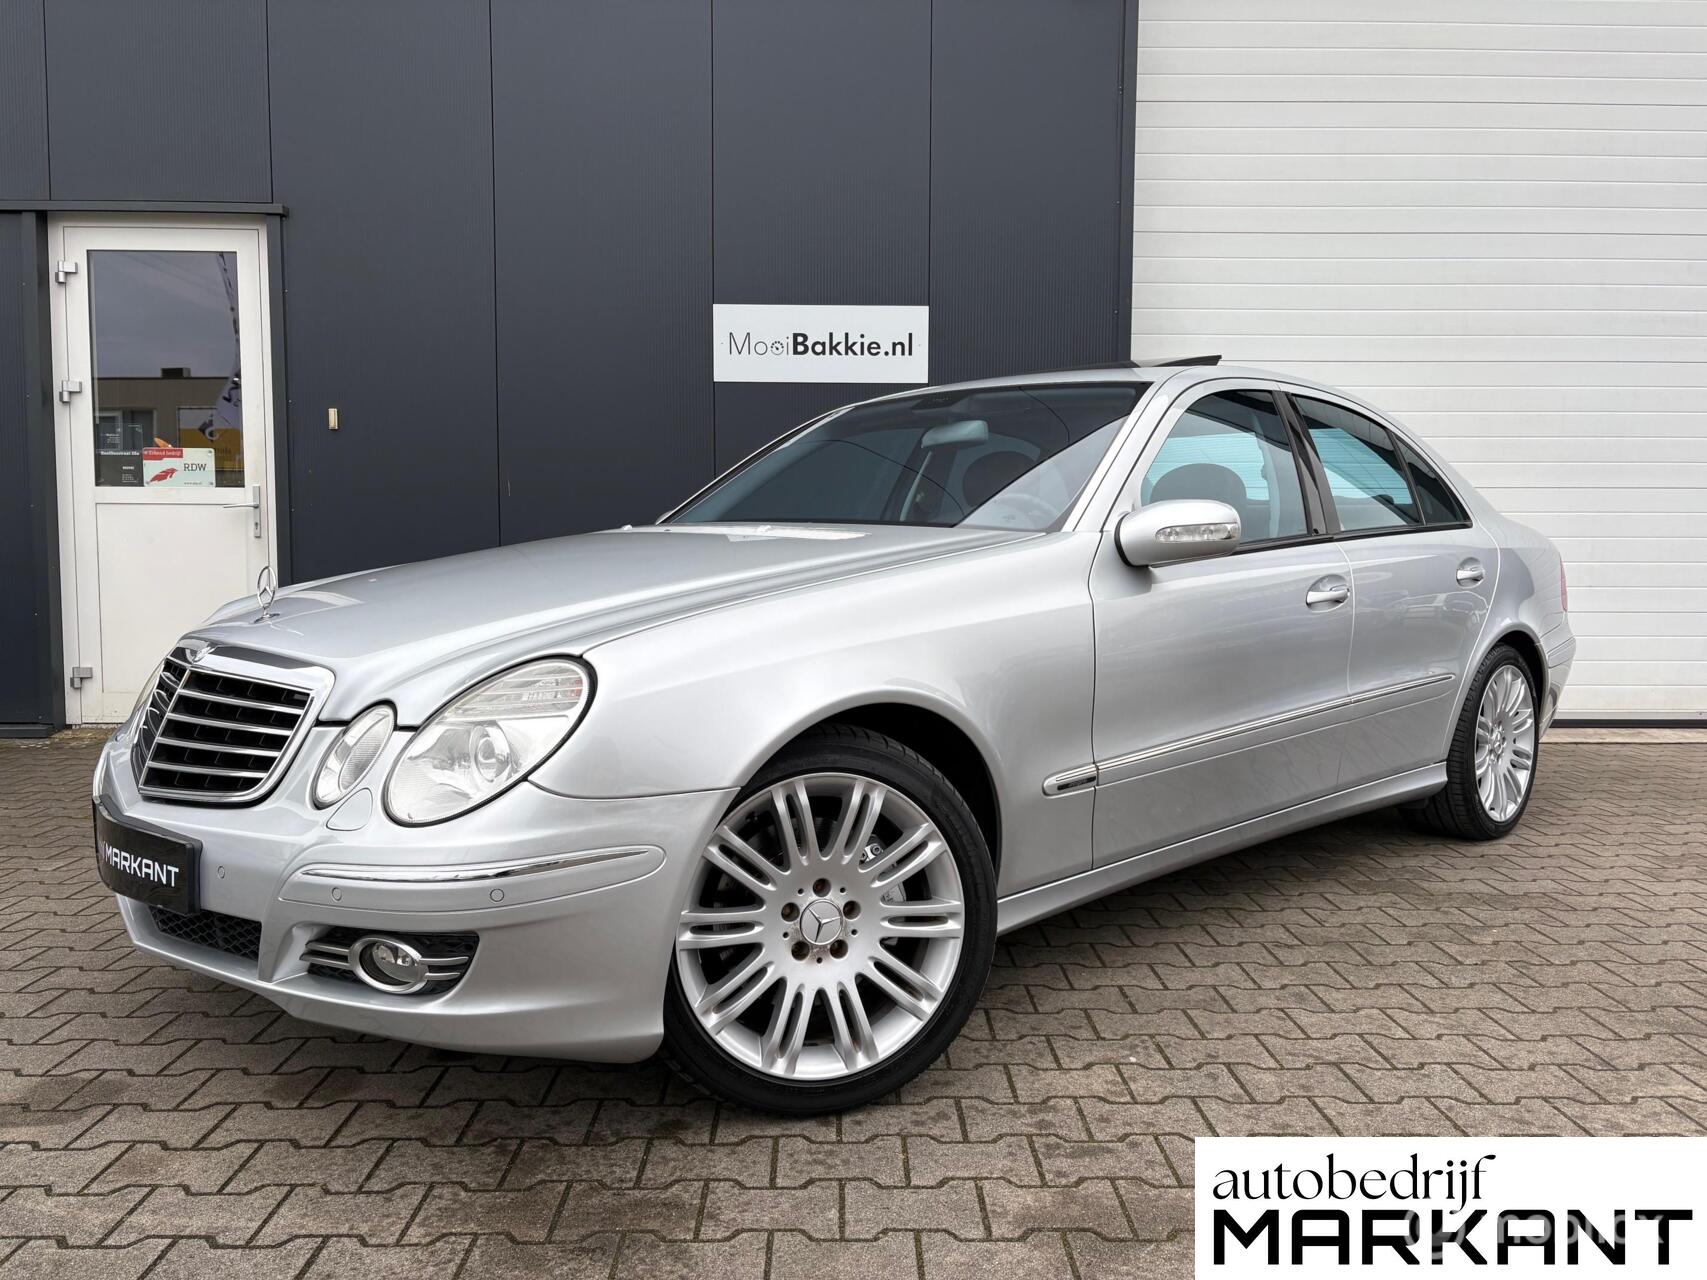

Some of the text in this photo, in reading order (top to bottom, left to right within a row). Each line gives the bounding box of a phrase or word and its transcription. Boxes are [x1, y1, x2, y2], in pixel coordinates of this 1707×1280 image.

[729, 331, 913, 357] MooiBakkie.nl
[183, 463, 207, 472] RDW
[105, 842, 179, 887] MARKANT
